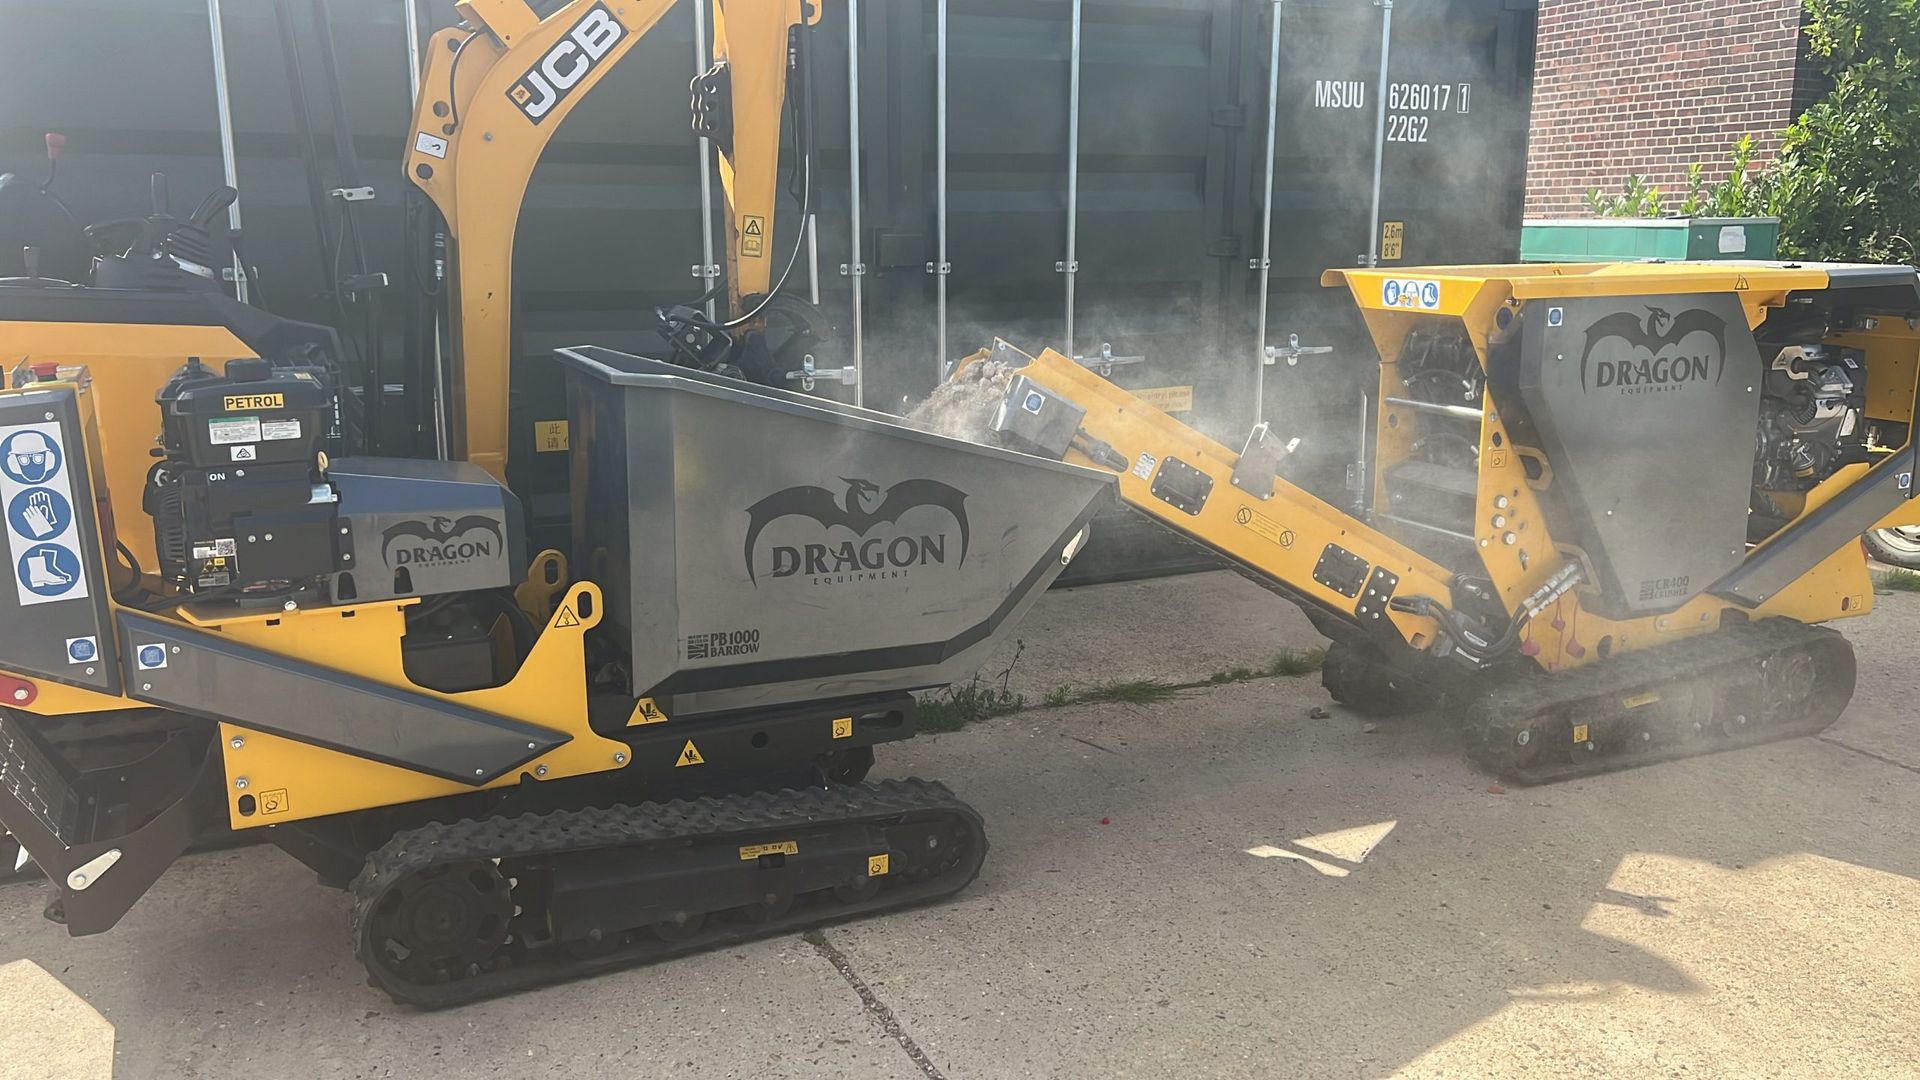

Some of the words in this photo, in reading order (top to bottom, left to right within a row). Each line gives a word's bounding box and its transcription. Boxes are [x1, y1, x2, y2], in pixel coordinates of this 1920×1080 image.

[525, 9, 622, 118] JCB
[1314, 80, 1365, 108] MSUU
[1389, 83, 1451, 111] 626017
[1460, 85, 1468, 112] 1
[1387, 115, 1428, 142] 22G2
[1597, 355, 1709, 387] DRAGON
[225, 395, 283, 409] PETROL
[209, 472, 226, 481] ON
[396, 541, 490, 565] DRAGON
[772, 534, 946, 578] DRAGON
[814, 570, 909, 585] EQUIPMENT
[710, 629, 760, 647] PB1000
[710, 643, 760, 658] BARROW
